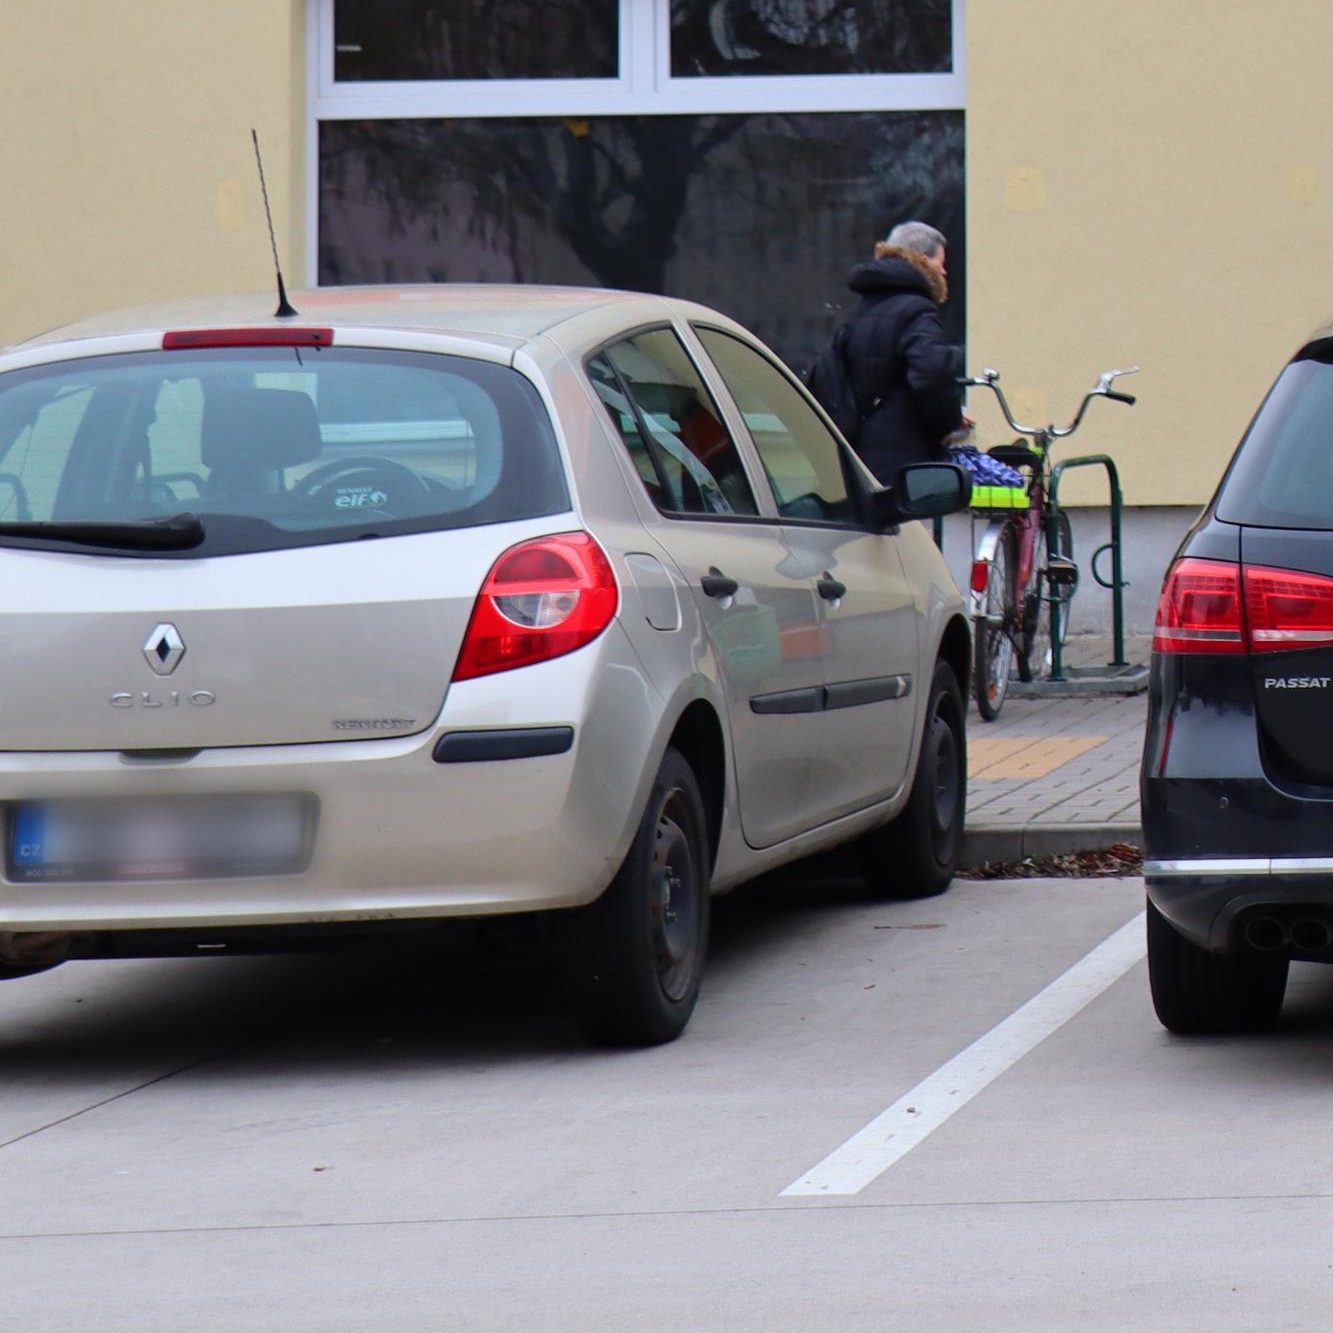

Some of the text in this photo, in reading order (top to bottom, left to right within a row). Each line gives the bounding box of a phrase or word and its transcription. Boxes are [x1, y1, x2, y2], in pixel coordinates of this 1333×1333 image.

[335, 493, 369, 507] elf
[1263, 675, 1331, 690] PASSAT
[108, 689, 217, 709] CLIO
[332, 717, 417, 731] RENAULT
[19, 843, 42, 857] CZ
